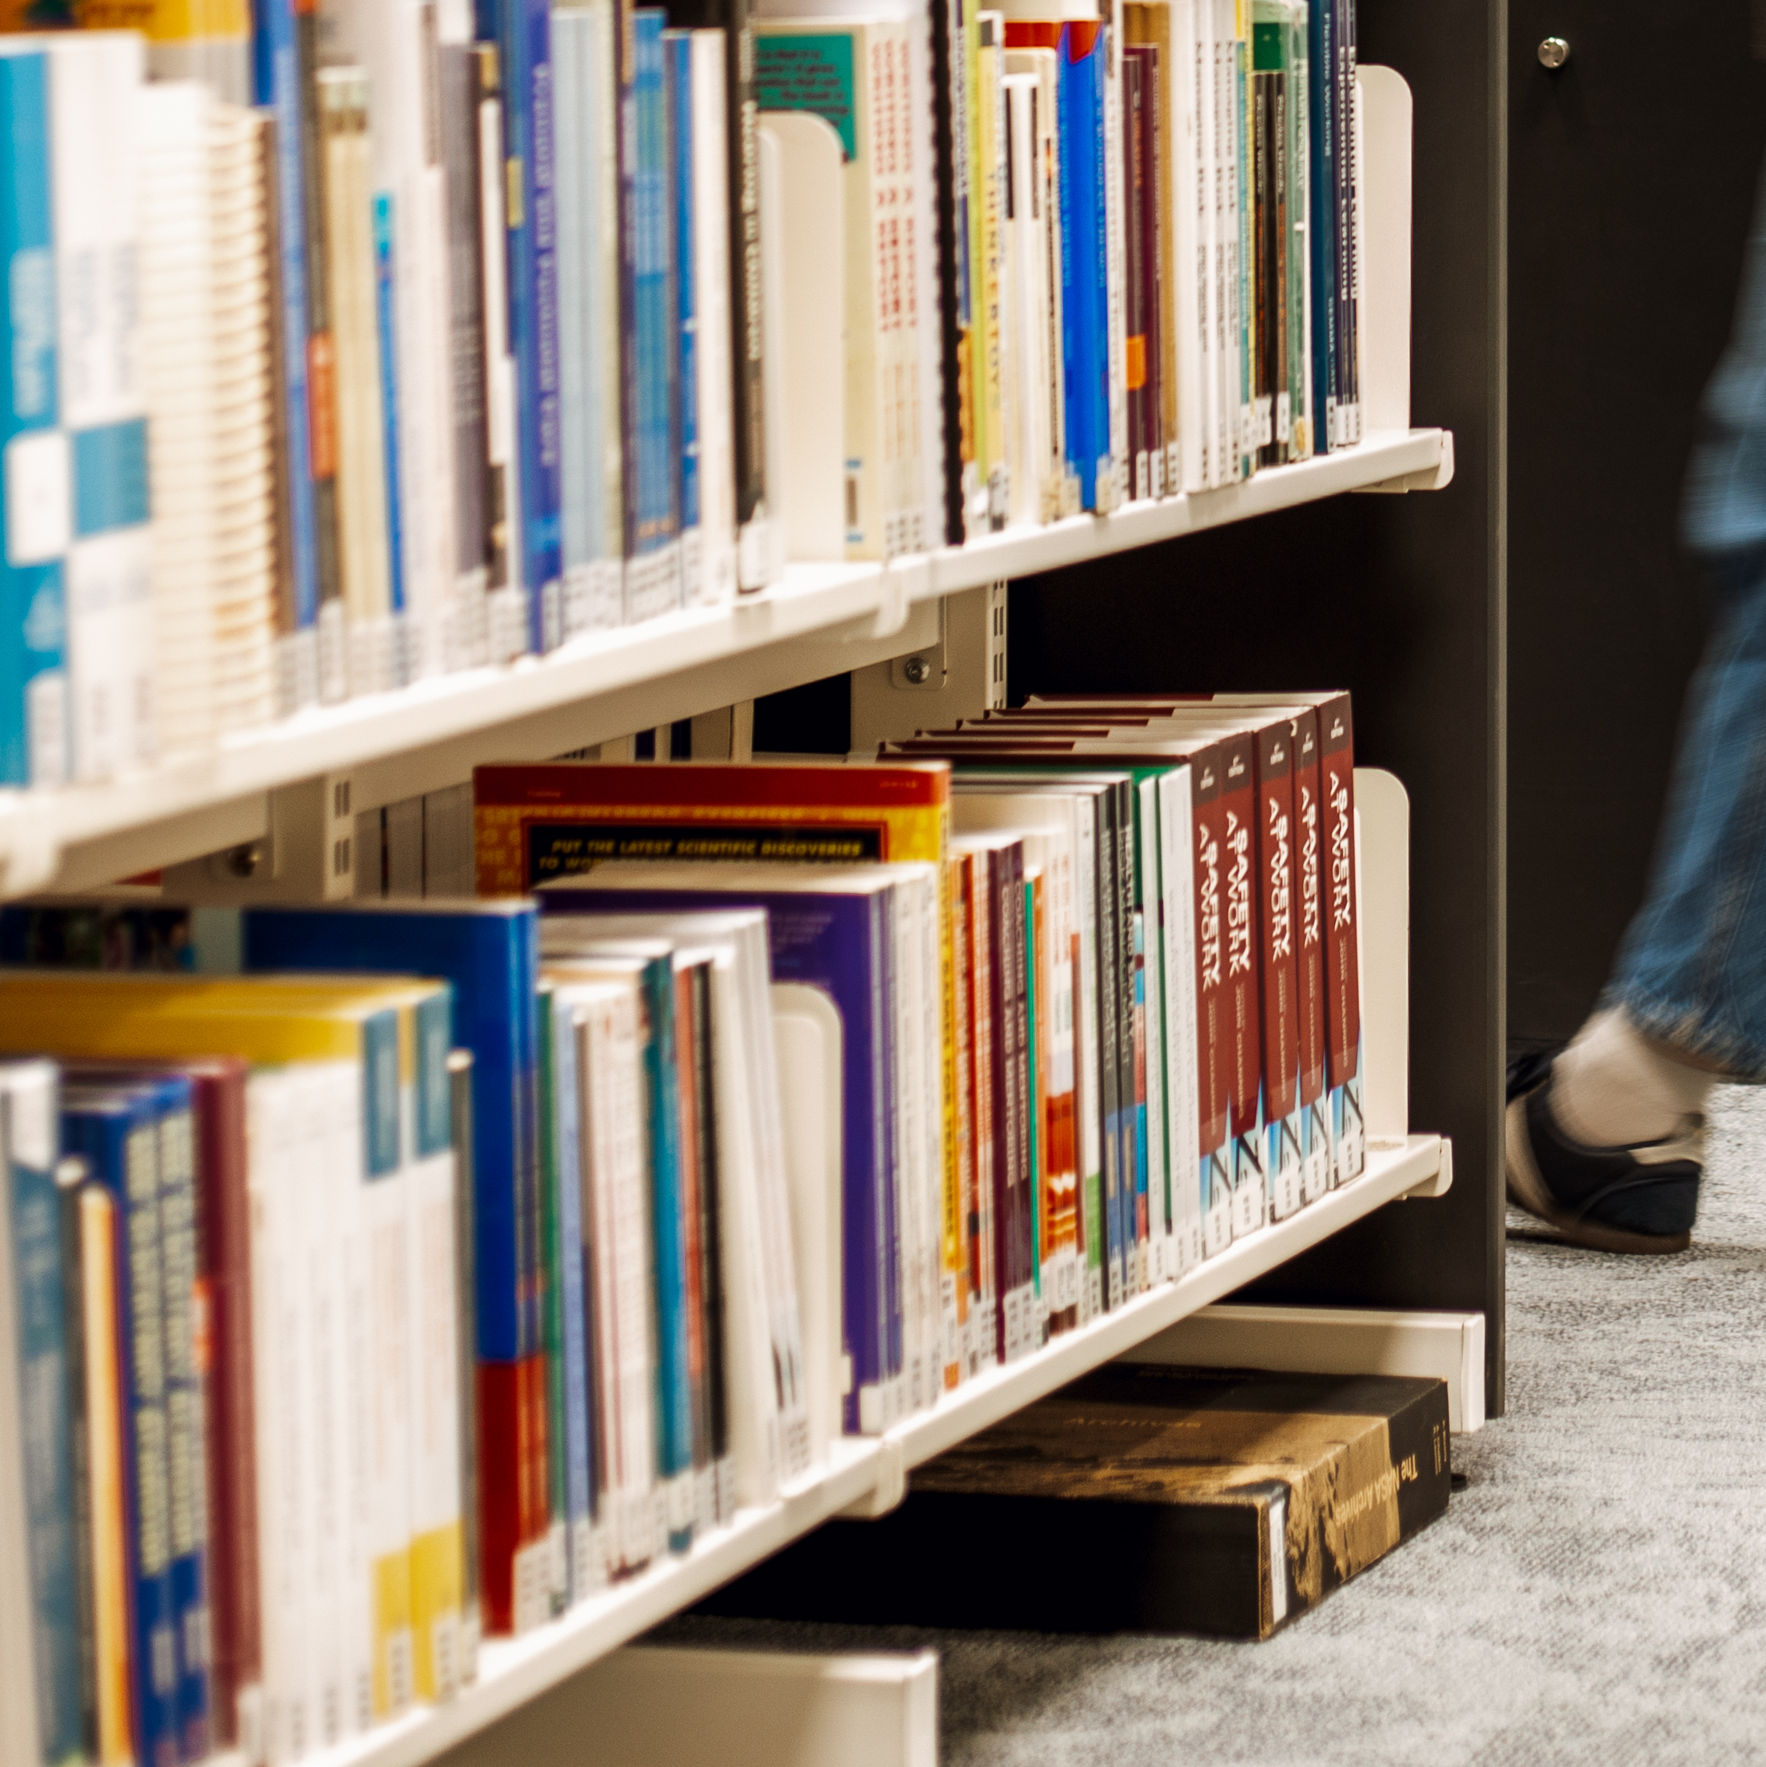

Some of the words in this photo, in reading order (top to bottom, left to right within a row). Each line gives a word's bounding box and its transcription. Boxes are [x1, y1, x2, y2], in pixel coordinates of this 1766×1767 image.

[1324, 13, 1332, 80] Flexible
[1324, 84, 1332, 157] Working
[1338, 46, 1347, 188] Experiential
[1348, 46, 1357, 188] Experiential
[1350, 197, 1358, 301] Learning
[1226, 810, 1238, 855] AT
[1269, 797, 1280, 841] AT
[1301, 786, 1310, 828] AT
[1330, 771, 1341, 814] AT
[551, 839, 583, 854] PUT
[586, 839, 616, 854] THE
[618, 838, 674, 854] LATEST
[676, 838, 757, 856] SCIENTIFIC
[760, 838, 864, 857] DISCOVERIES
[1199, 824, 1211, 869] AT
[1276, 815, 1291, 957] SAFETY
[1302, 838, 1313, 949] WORK
[1307, 803, 1319, 944] SAFETY
[1331, 823, 1345, 933] WORK
[1336, 786, 1351, 927] SAFETY
[1002, 885, 1012, 1002] COACHING
[1014, 880, 1024, 995] COACHING
[1200, 878, 1214, 993] WORK
[1208, 840, 1222, 986] SAFETY
[1227, 864, 1241, 979] WORK
[1236, 827, 1250, 972] SAFETY
[1270, 850, 1283, 963] WORK
[1004, 1006, 1013, 1055] AND
[1017, 1000, 1026, 1048] AND
[1279, 1017, 1287, 1102] CHANNING
[1309, 1001, 1317, 1086] CHANNING
[1341, 984, 1349, 1068] CHANNING
[1005, 1058, 1016, 1188] MENTORING
[1019, 1051, 1029, 1181] MENTORING
[1335, 1482, 1373, 1528] Archives
[1375, 1465, 1400, 1505] NASA
[1401, 1452, 1418, 1482] The
